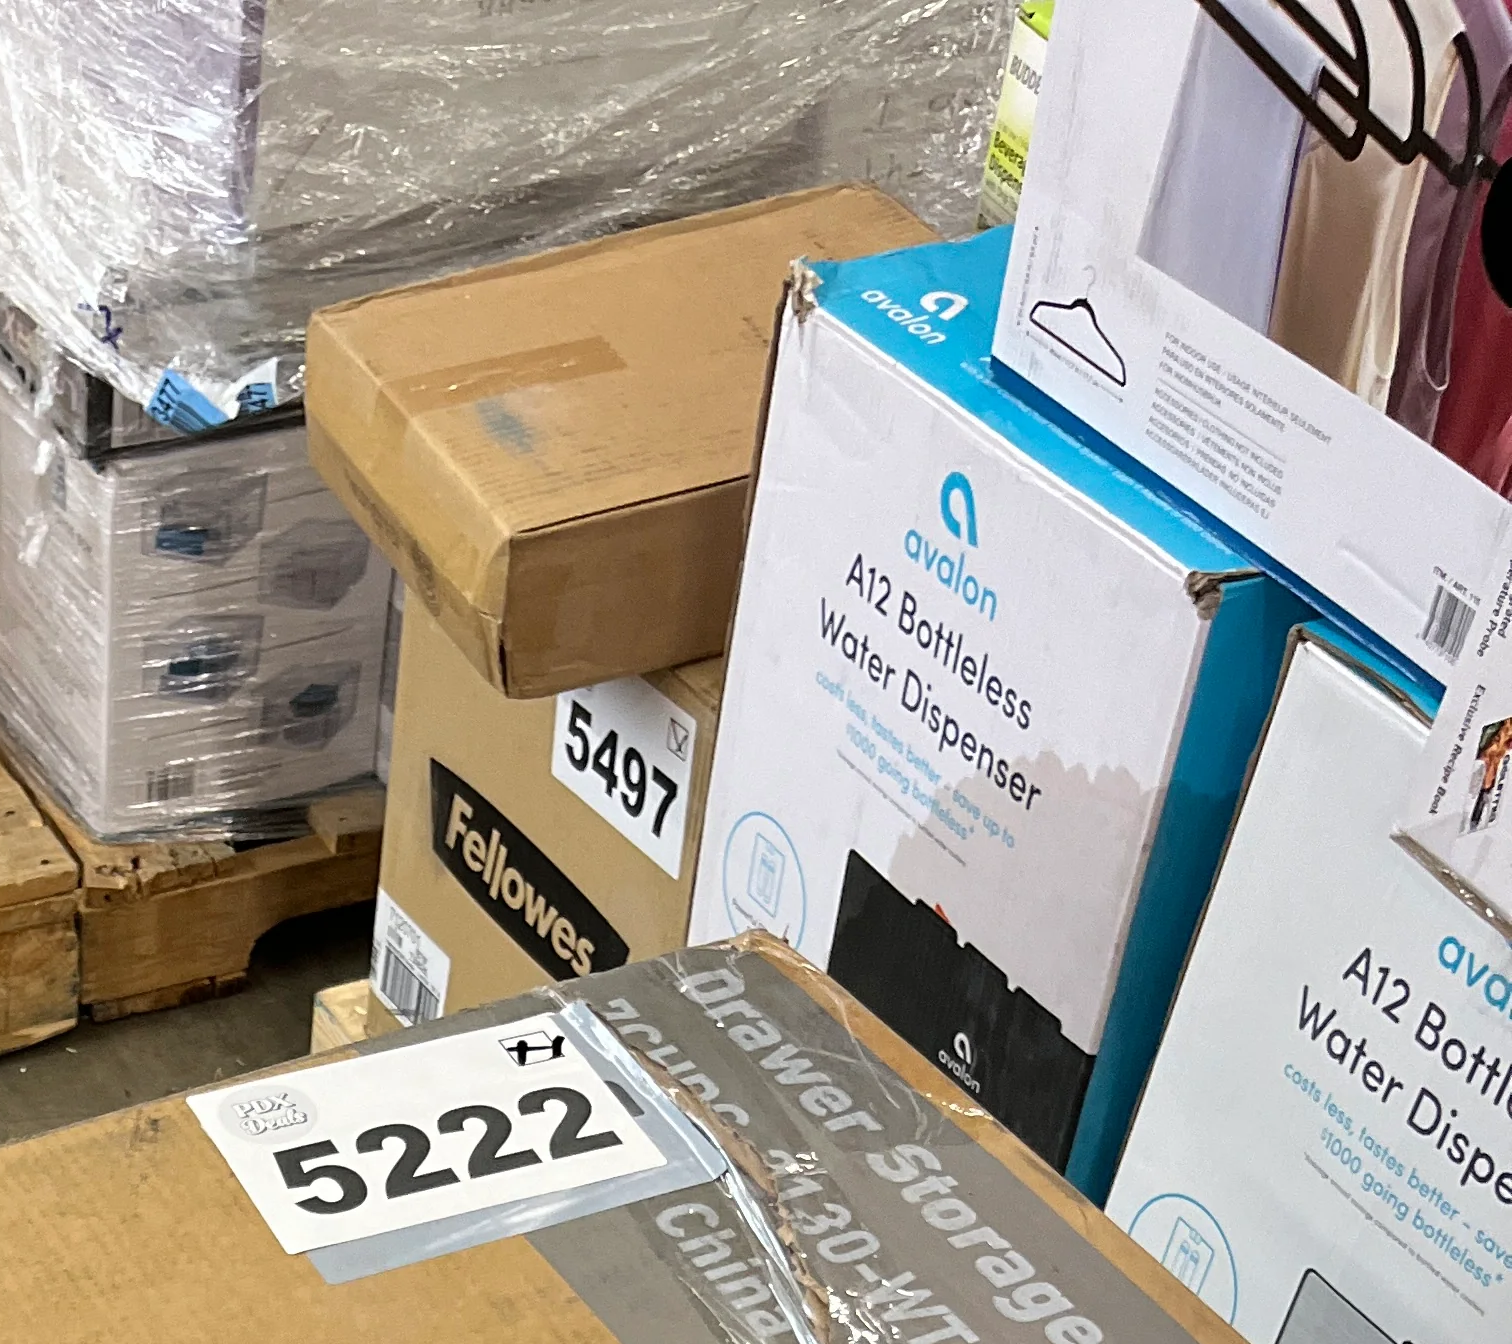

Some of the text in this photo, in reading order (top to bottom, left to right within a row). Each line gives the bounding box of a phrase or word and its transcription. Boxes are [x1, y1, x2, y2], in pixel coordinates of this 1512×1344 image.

[860, 289, 947, 345] avalon
[904, 529, 998, 622] avalon
[1476, 619, 1498, 657] Probe
[820, 596, 897, 691] Water
[901, 668, 1042, 810] Dispenser
[845, 553, 1033, 730] A12 Bottleless
[564, 700, 679, 839] 5497
[878, 754, 911, 794] going
[906, 744, 942, 785] better
[952, 789, 981, 820] save
[982, 815, 1001, 837] up
[1001, 827, 1015, 849] to
[1428, 684, 1487, 815] Exclusive Recipe Book
[444, 793, 597, 976] Fellowes
[1342, 945, 1512, 1120] A12 Bottl
[1437, 935, 1512, 1018] ava
[230, 1091, 297, 1120] PDX
[684, 967, 884, 1134] Drawer
[937, 1048, 982, 1096] avalon
[1297, 984, 1512, 1205] Water Dispe
[239, 1106, 308, 1138] Deals
[271, 1087, 623, 1214] 5222
[1283, 1063, 1322, 1104] costs
[1322, 1092, 1356, 1136] less,
[1358, 1126, 1407, 1178] tastes
[1407, 1167, 1461, 1221] better
[1475, 1229, 1512, 1270] save
[1361, 1172, 1410, 1222] going
[654, 1202, 791, 1339] China
